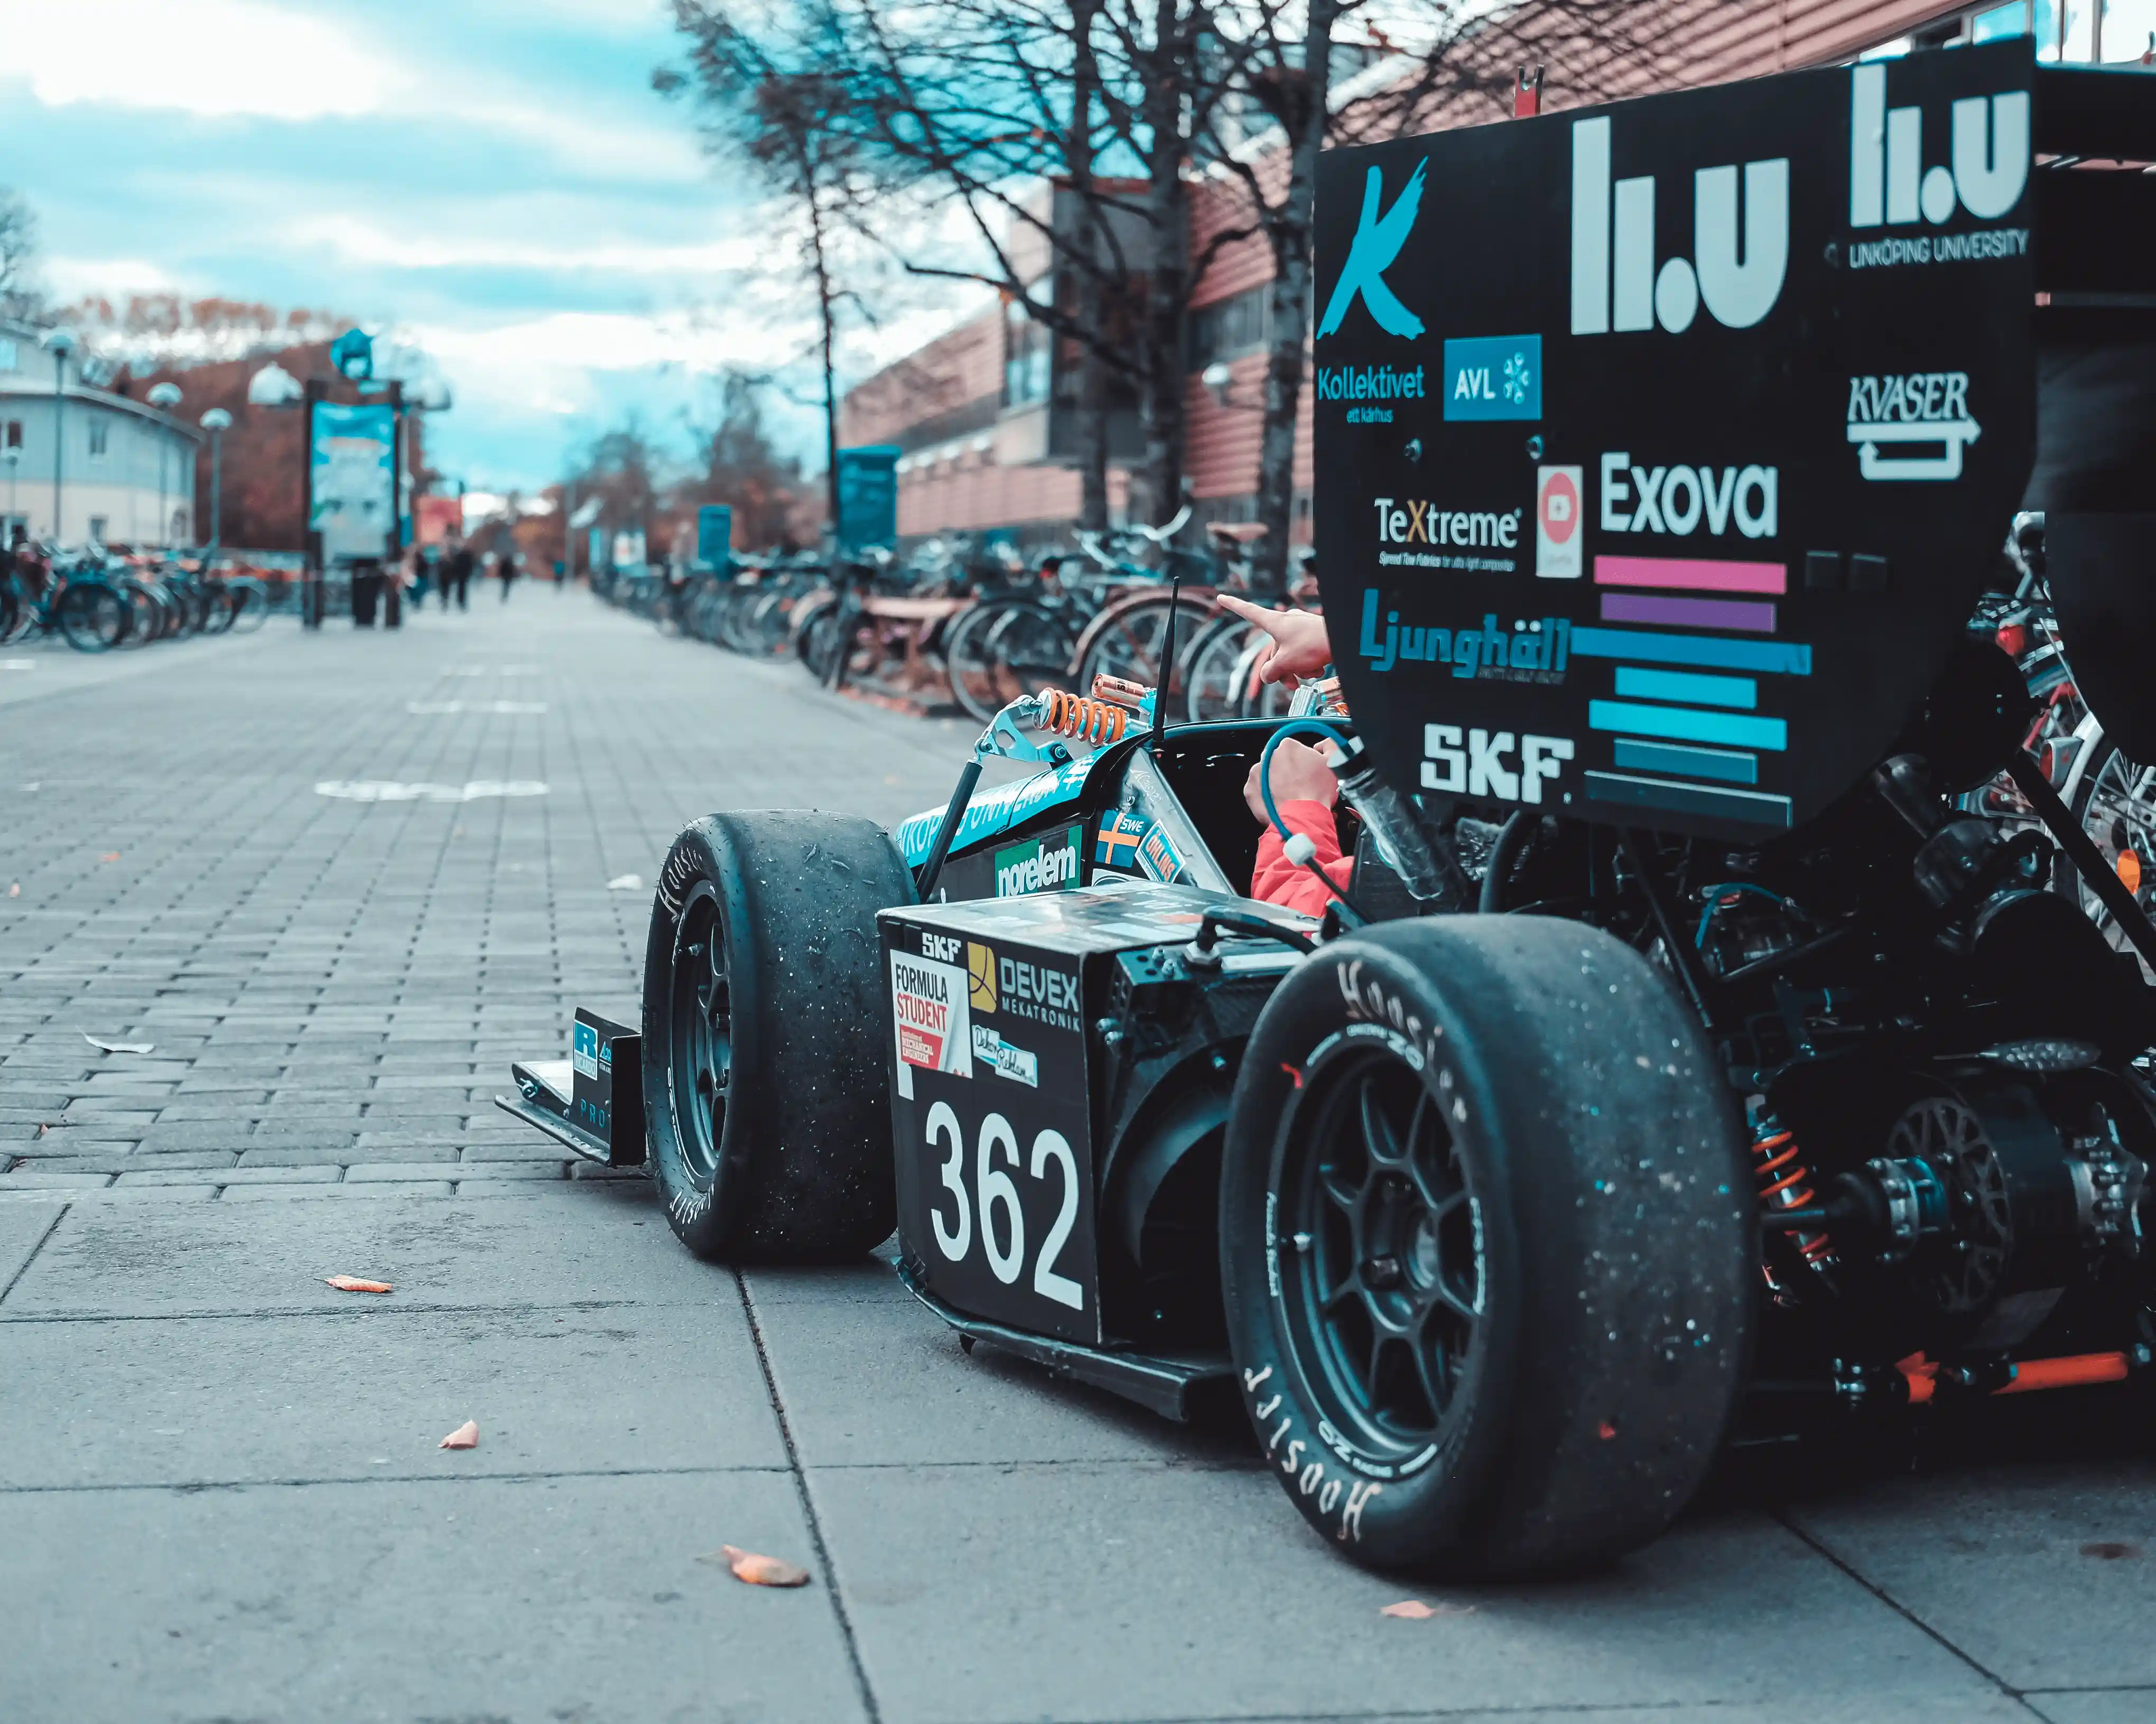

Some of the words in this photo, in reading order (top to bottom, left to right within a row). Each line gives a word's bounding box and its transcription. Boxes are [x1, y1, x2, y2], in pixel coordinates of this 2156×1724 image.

[1850, 236, 1931, 268] LINKÖPING
[1934, 228, 2029, 262] UNIVERSITY
[1318, 364, 1425, 400] Kollektivet
[1454, 367, 1497, 400] AVL
[1847, 371, 1969, 422] KVASER
[1601, 452, 1778, 537] Exova
[1359, 588, 1570, 678] Ljunghäll
[1421, 723, 1574, 804] SKF
[1120, 818, 1145, 833] SWE
[998, 844, 1076, 898] norelem
[922, 932, 961, 962] SKF
[895, 963, 948, 1003] FORMULA
[1000, 957, 1079, 1013] DEVEX
[897, 992, 947, 1032] STUDENT
[1001, 996, 1080, 1032] MEKATRONIK
[925, 1101, 1083, 1311] 362
